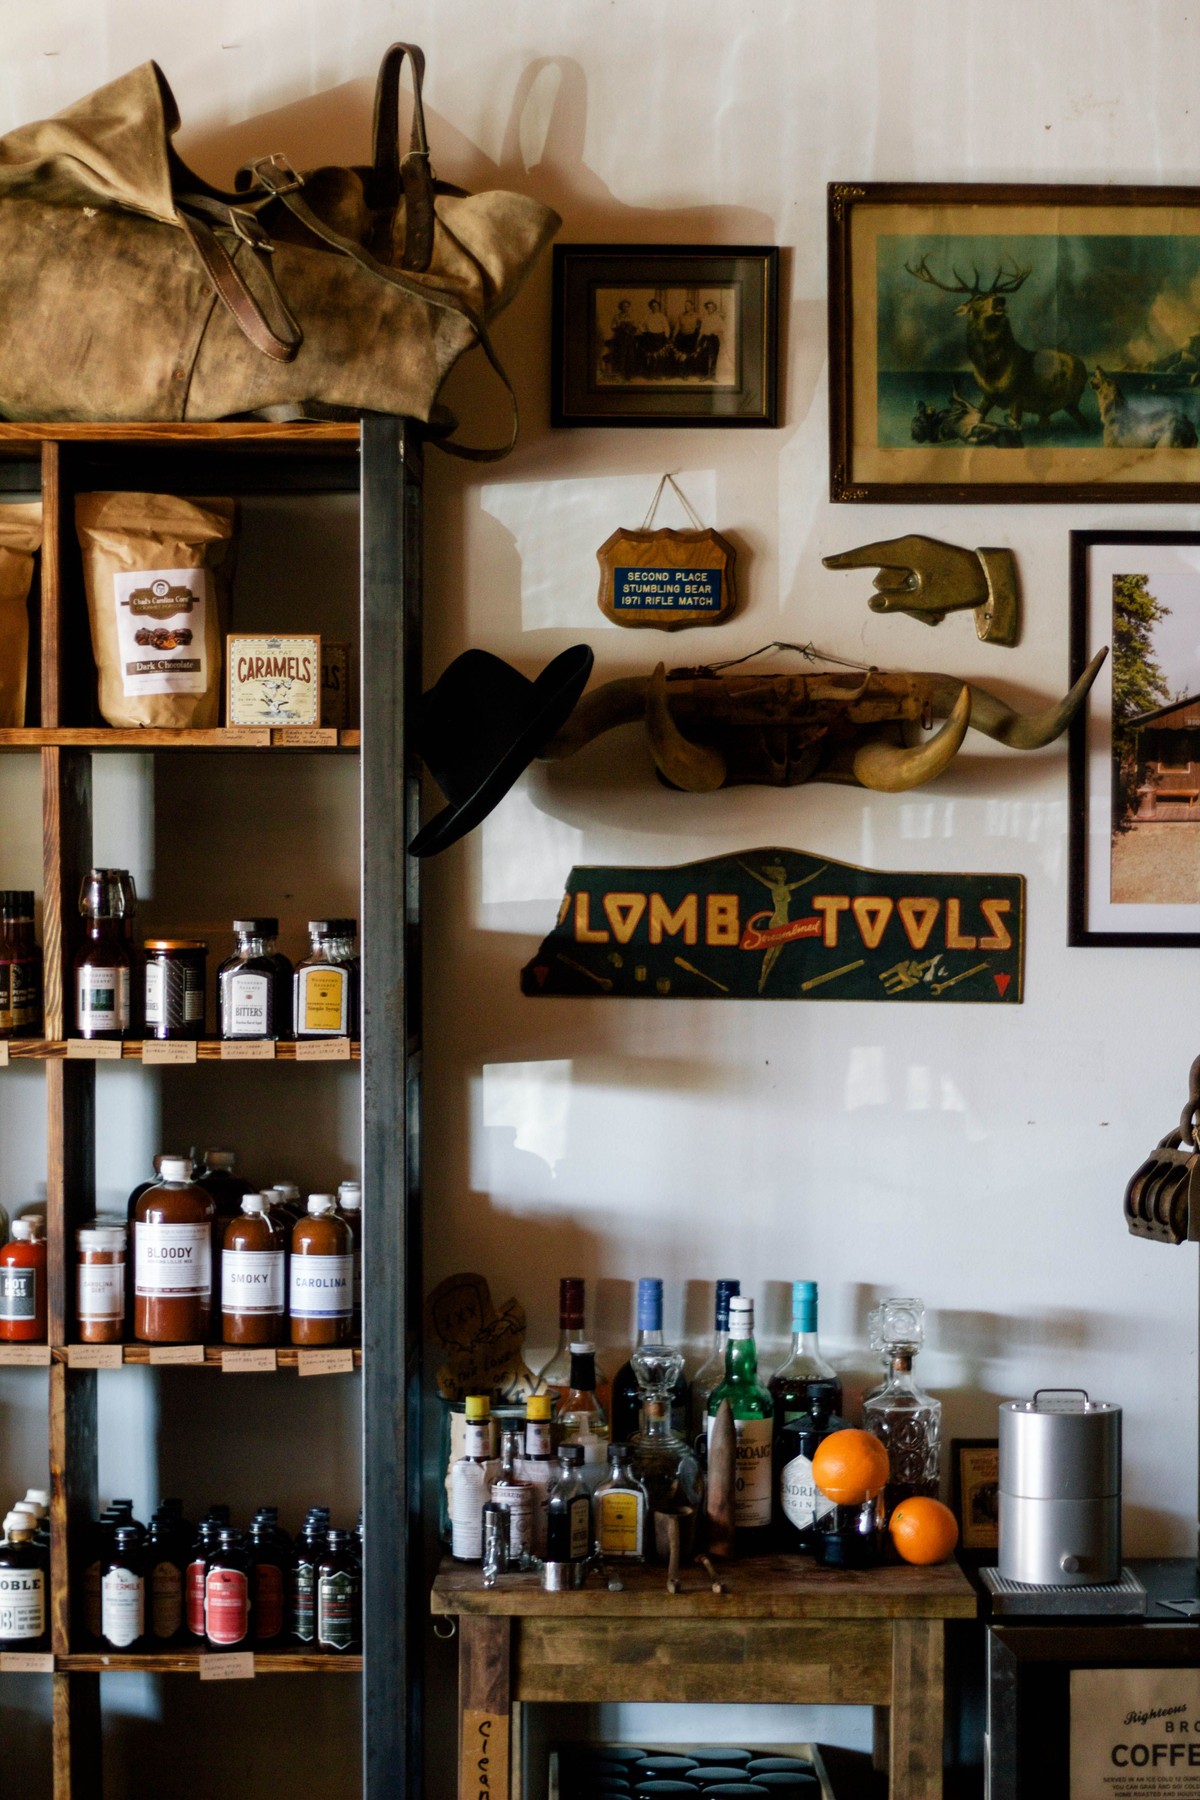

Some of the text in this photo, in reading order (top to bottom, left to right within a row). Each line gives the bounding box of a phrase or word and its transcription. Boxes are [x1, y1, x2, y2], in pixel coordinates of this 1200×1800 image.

[627, 572, 708, 582] SECOND PLACE
[622, 584, 712, 594] STUMBLING BEAR
[621, 596, 713, 606] 1971 RIFLE MATCH
[136, 660, 194, 671] Dark Chocolate
[237, 656, 311, 683] CARAMELS
[558, 892, 740, 947] LOMB
[812, 895, 1012, 951] TOOLS
[744, 910, 822, 949] Streamlined
[235, 1007, 263, 1017] BITTERS
[147, 1247, 193, 1259] BLOODY
[4, 1278, 27, 1289] HOT
[230, 1273, 269, 1284] SMOKY
[295, 1277, 347, 1288] CAROLINA
[4, 1289, 26, 1297] MESS
[1123, 1703, 1187, 1725] Righteous
